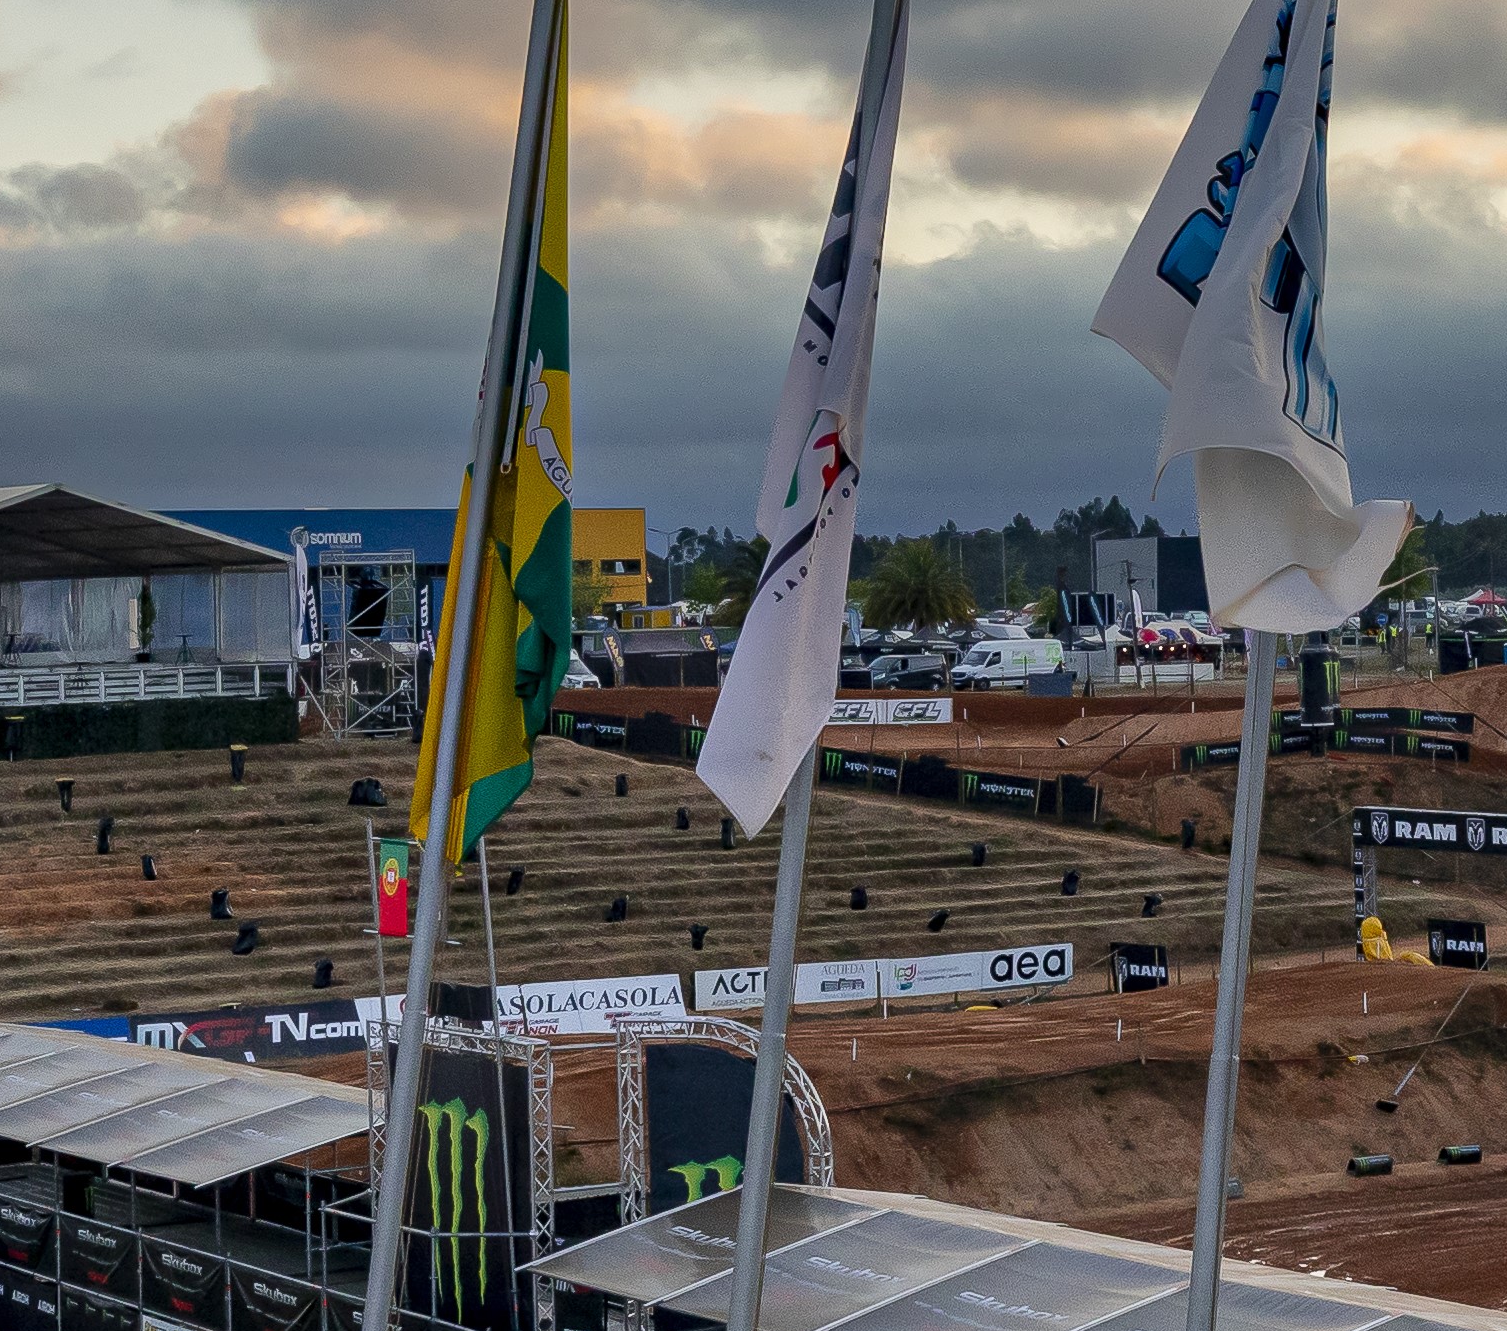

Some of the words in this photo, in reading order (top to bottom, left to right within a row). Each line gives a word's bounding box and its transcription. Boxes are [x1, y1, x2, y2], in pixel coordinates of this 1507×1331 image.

[1395, 820, 1456, 842] RAM
[1446, 939, 1484, 953] RAM
[990, 948, 1067, 983] aea
[1130, 964, 1166, 978] RAM
[498, 994, 578, 1017] ASOLA
[579, 986, 681, 1010] CASOLA
